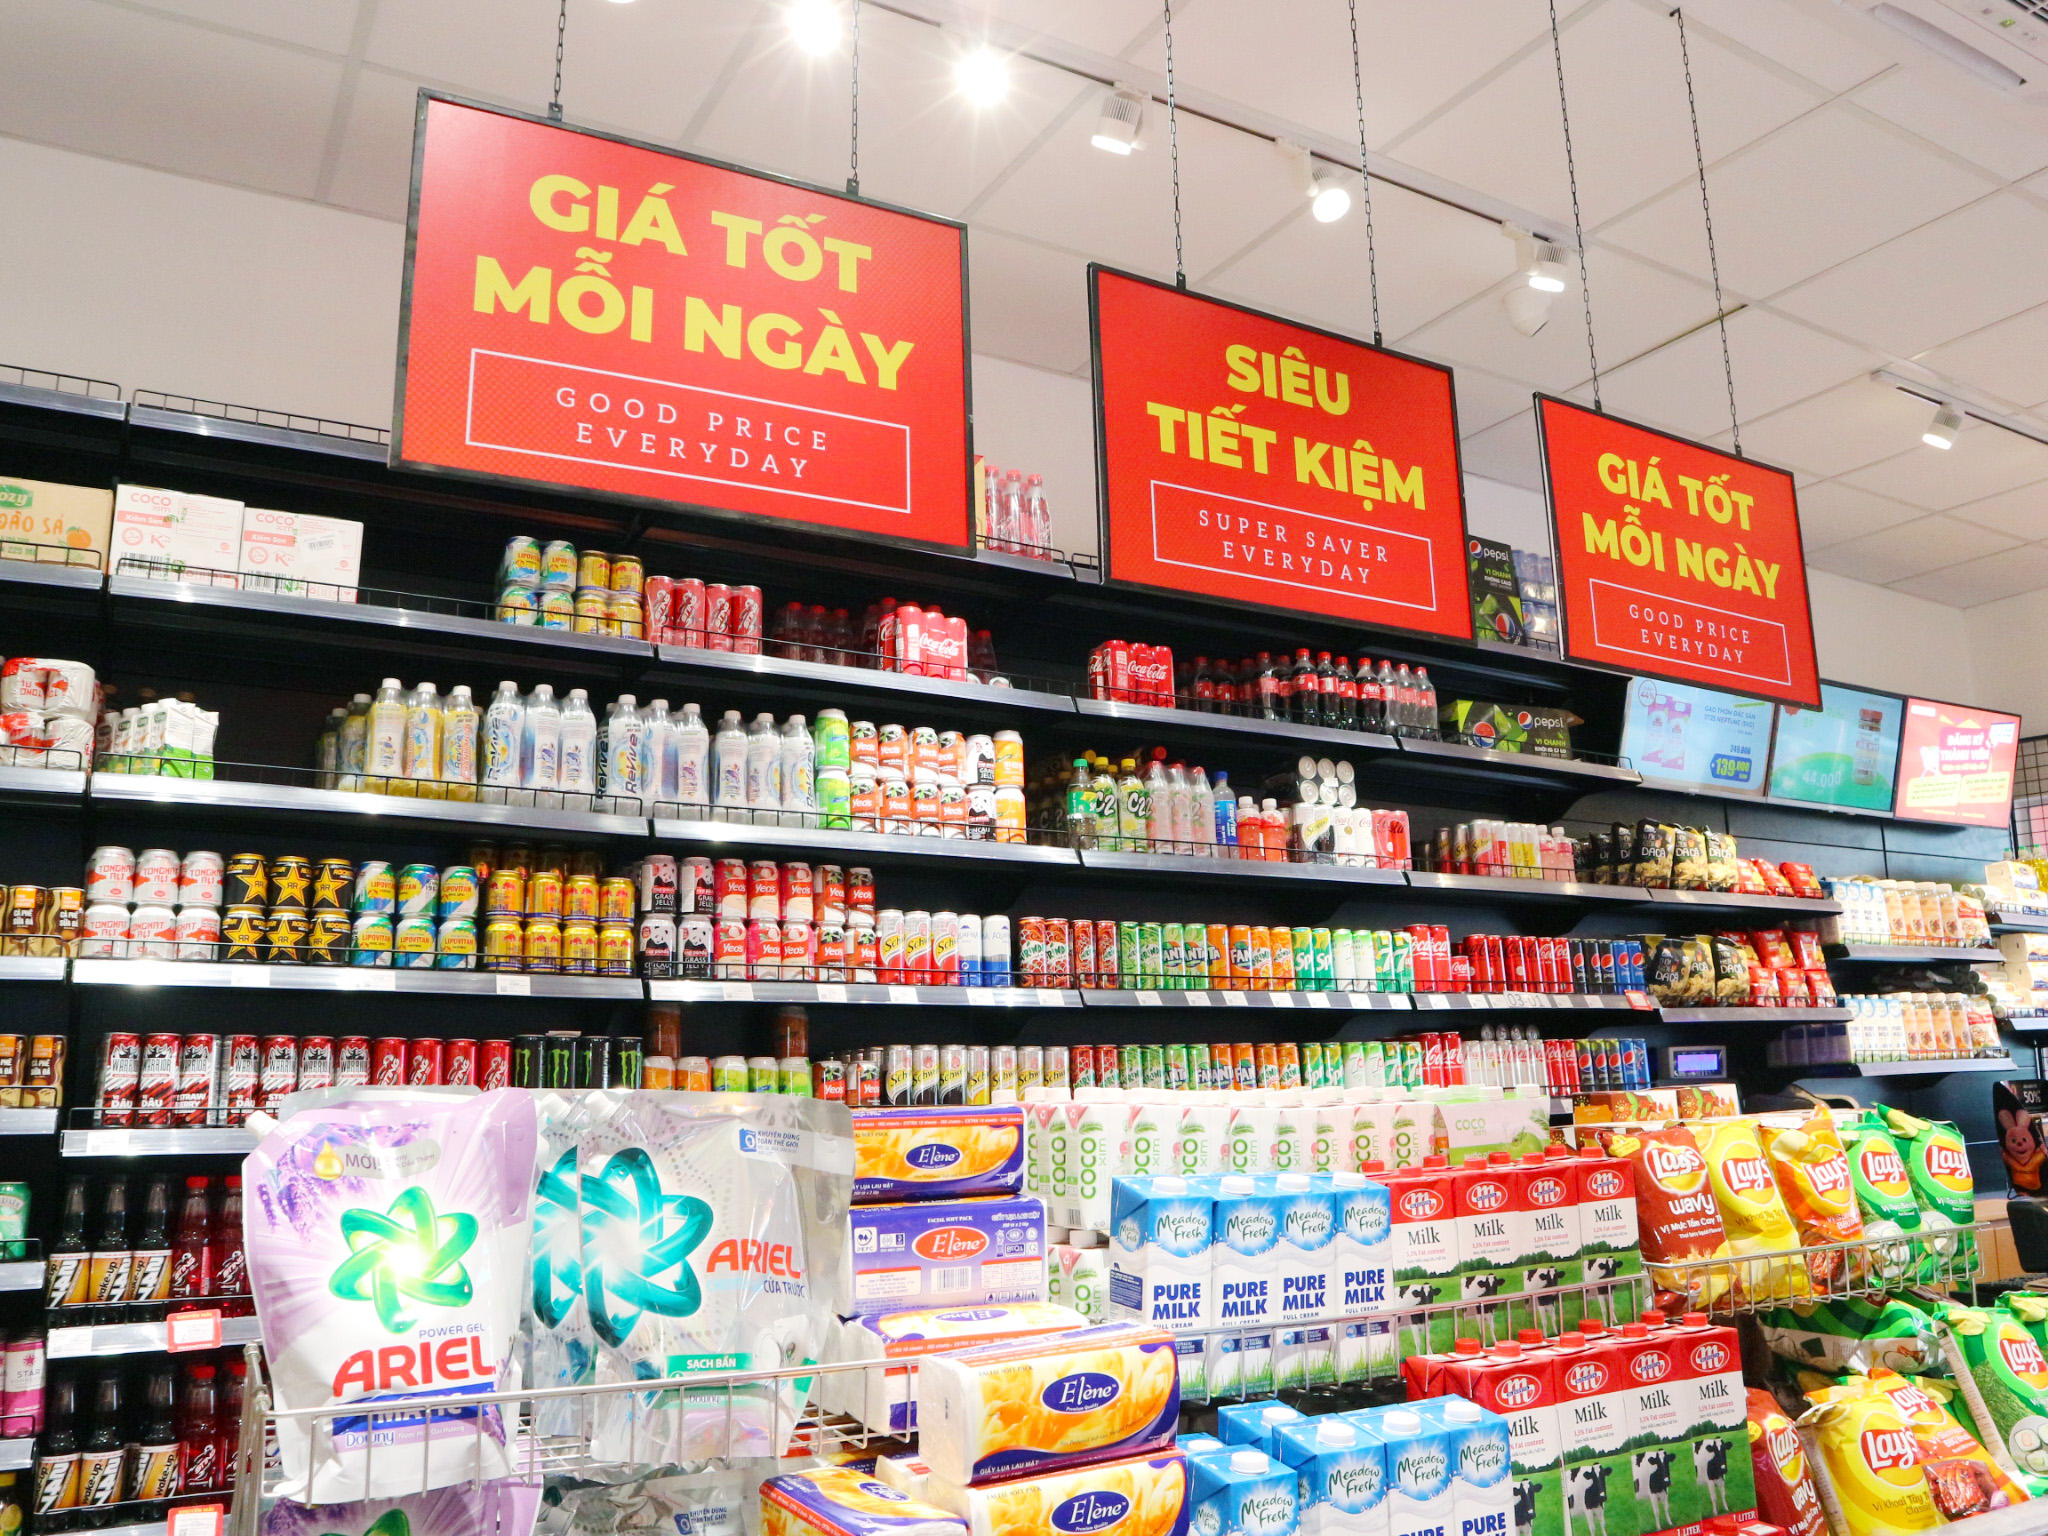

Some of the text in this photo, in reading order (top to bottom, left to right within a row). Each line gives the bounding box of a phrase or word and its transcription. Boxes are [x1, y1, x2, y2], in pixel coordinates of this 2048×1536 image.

[529, 174, 872, 293] GIÁ TỐT
[473, 247, 914, 390] MỖI NGÀY
[1225, 344, 1351, 416] SIÊU
[556, 387, 828, 452] GOOD PRICE
[576, 423, 809, 478] EVERYDAY
[1146, 401, 1425, 511] TIẾT KIỆM
[130, 493, 172, 507] COCO
[1597, 452, 1754, 531] GIÁ TỐT
[256, 513, 295, 526] COCO
[1199, 510, 1388, 563] SUPER SAVER
[1483, 548, 1509, 561] pepsi
[1582, 504, 1780, 599] MỖI NGÀY
[1223, 542, 1371, 584] EVERYDAY
[1629, 604, 1750, 644] GOOD PRICE
[919, 633, 964, 656] Coca-Cola
[1641, 629, 1744, 663] EVERYDAY
[1127, 661, 1169, 680] Coca-Cola
[1534, 717, 1565, 729] pepsi
[655, 893, 675, 901] GRASS
[755, 883, 776, 893] Yeo's
[791, 884, 811, 895] Yeo's
[854, 889, 873, 899] Yeo's
[722, 942, 744, 953] Yeo's
[784, 945, 805, 955] Yeo's
[824, 946, 844, 956] Yeo's
[1508, 993, 1546, 1008] 03-01
[142, 1058, 171, 1072] WARRIOR
[269, 1059, 297, 1073] WARRIOR
[304, 1060, 333, 1073] WARRIOR
[824, 1085, 844, 1095] Yeo's
[1456, 1117, 1486, 1131] COCO
[1080, 1137, 1097, 1200] COCO
[1650, 1148, 1700, 1180] Lay's
[1726, 1156, 1772, 1191] Lay's
[1806, 1155, 1850, 1193] Lay's
[1865, 1151, 1904, 1184] Lay's
[1593, 1204, 1623, 1223] Milk
[1667, 1193, 1716, 1216] wavy
[1157, 1211, 1208, 1238] Meadow
[1226, 1213, 1274, 1238] Meadow
[1285, 1208, 1331, 1233] Meadow
[1344, 1203, 1388, 1228] Meadow
[1534, 1212, 1565, 1232] Milk
[1660, 1224, 1671, 1235] Vị
[1701, 1217, 1716, 1229] Cay
[1174, 1225, 1204, 1243] Fresh
[1242, 1225, 1271, 1243] Fresh
[1301, 1221, 1329, 1241] Fresh
[1359, 1217, 1386, 1236] Fresh
[1407, 1226, 1441, 1247] Milk
[1473, 1218, 1505, 1238] Milk
[706, 1238, 802, 1280] ARIEL
[763, 1276, 781, 1295] CỬA
[1283, 1274, 1326, 1294] PURE
[1344, 1268, 1385, 1287] PURE
[1153, 1282, 1201, 1302] PURE
[1222, 1280, 1268, 1300] PURE
[1344, 1286, 1385, 1305] MILK
[1152, 1301, 1200, 1321] MILK
[1221, 1299, 1267, 1318] MILK
[1282, 1292, 1326, 1311] MILK
[1361, 1305, 1379, 1313] CREAM
[1282, 1311, 1320, 1321] FULL CREAM
[419, 1323, 485, 1339] POWER GEL
[686, 1358, 713, 1372] SẠCH
[2005, 1337, 2043, 1375] Lay's
[17, 1368, 41, 1379] STAR
[333, 1336, 498, 1398] ARIEL
[1058, 1375, 1113, 1406] Elène
[1699, 1379, 1729, 1400] Milk
[1639, 1389, 1672, 1412] Milk
[1888, 1385, 1931, 1423] Lay's
[1574, 1400, 1608, 1424] Milk
[1459, 1437, 1506, 1469] Meadow
[1772, 1426, 1799, 1467] Lay's
[1864, 1427, 1918, 1470] Lay's
[1397, 1450, 1446, 1483] Meadow
[1475, 1452, 1506, 1475] Fresh
[1328, 1462, 1380, 1497] Meadow
[1413, 1465, 1444, 1489] Fresh
[1345, 1478, 1378, 1499] Fresh
[1791, 1478, 1817, 1511] wavy
[1068, 1494, 1122, 1525] Elène
[1241, 1491, 1293, 1526] Meadow
[1872, 1493, 1924, 1512] Vị Khoai Tây
[1258, 1506, 1292, 1531] Fresh
[1462, 1511, 1507, 1535] PURE
[1738, 1511, 1756, 1523] LITER
[1683, 1524, 1701, 1535] LITER
